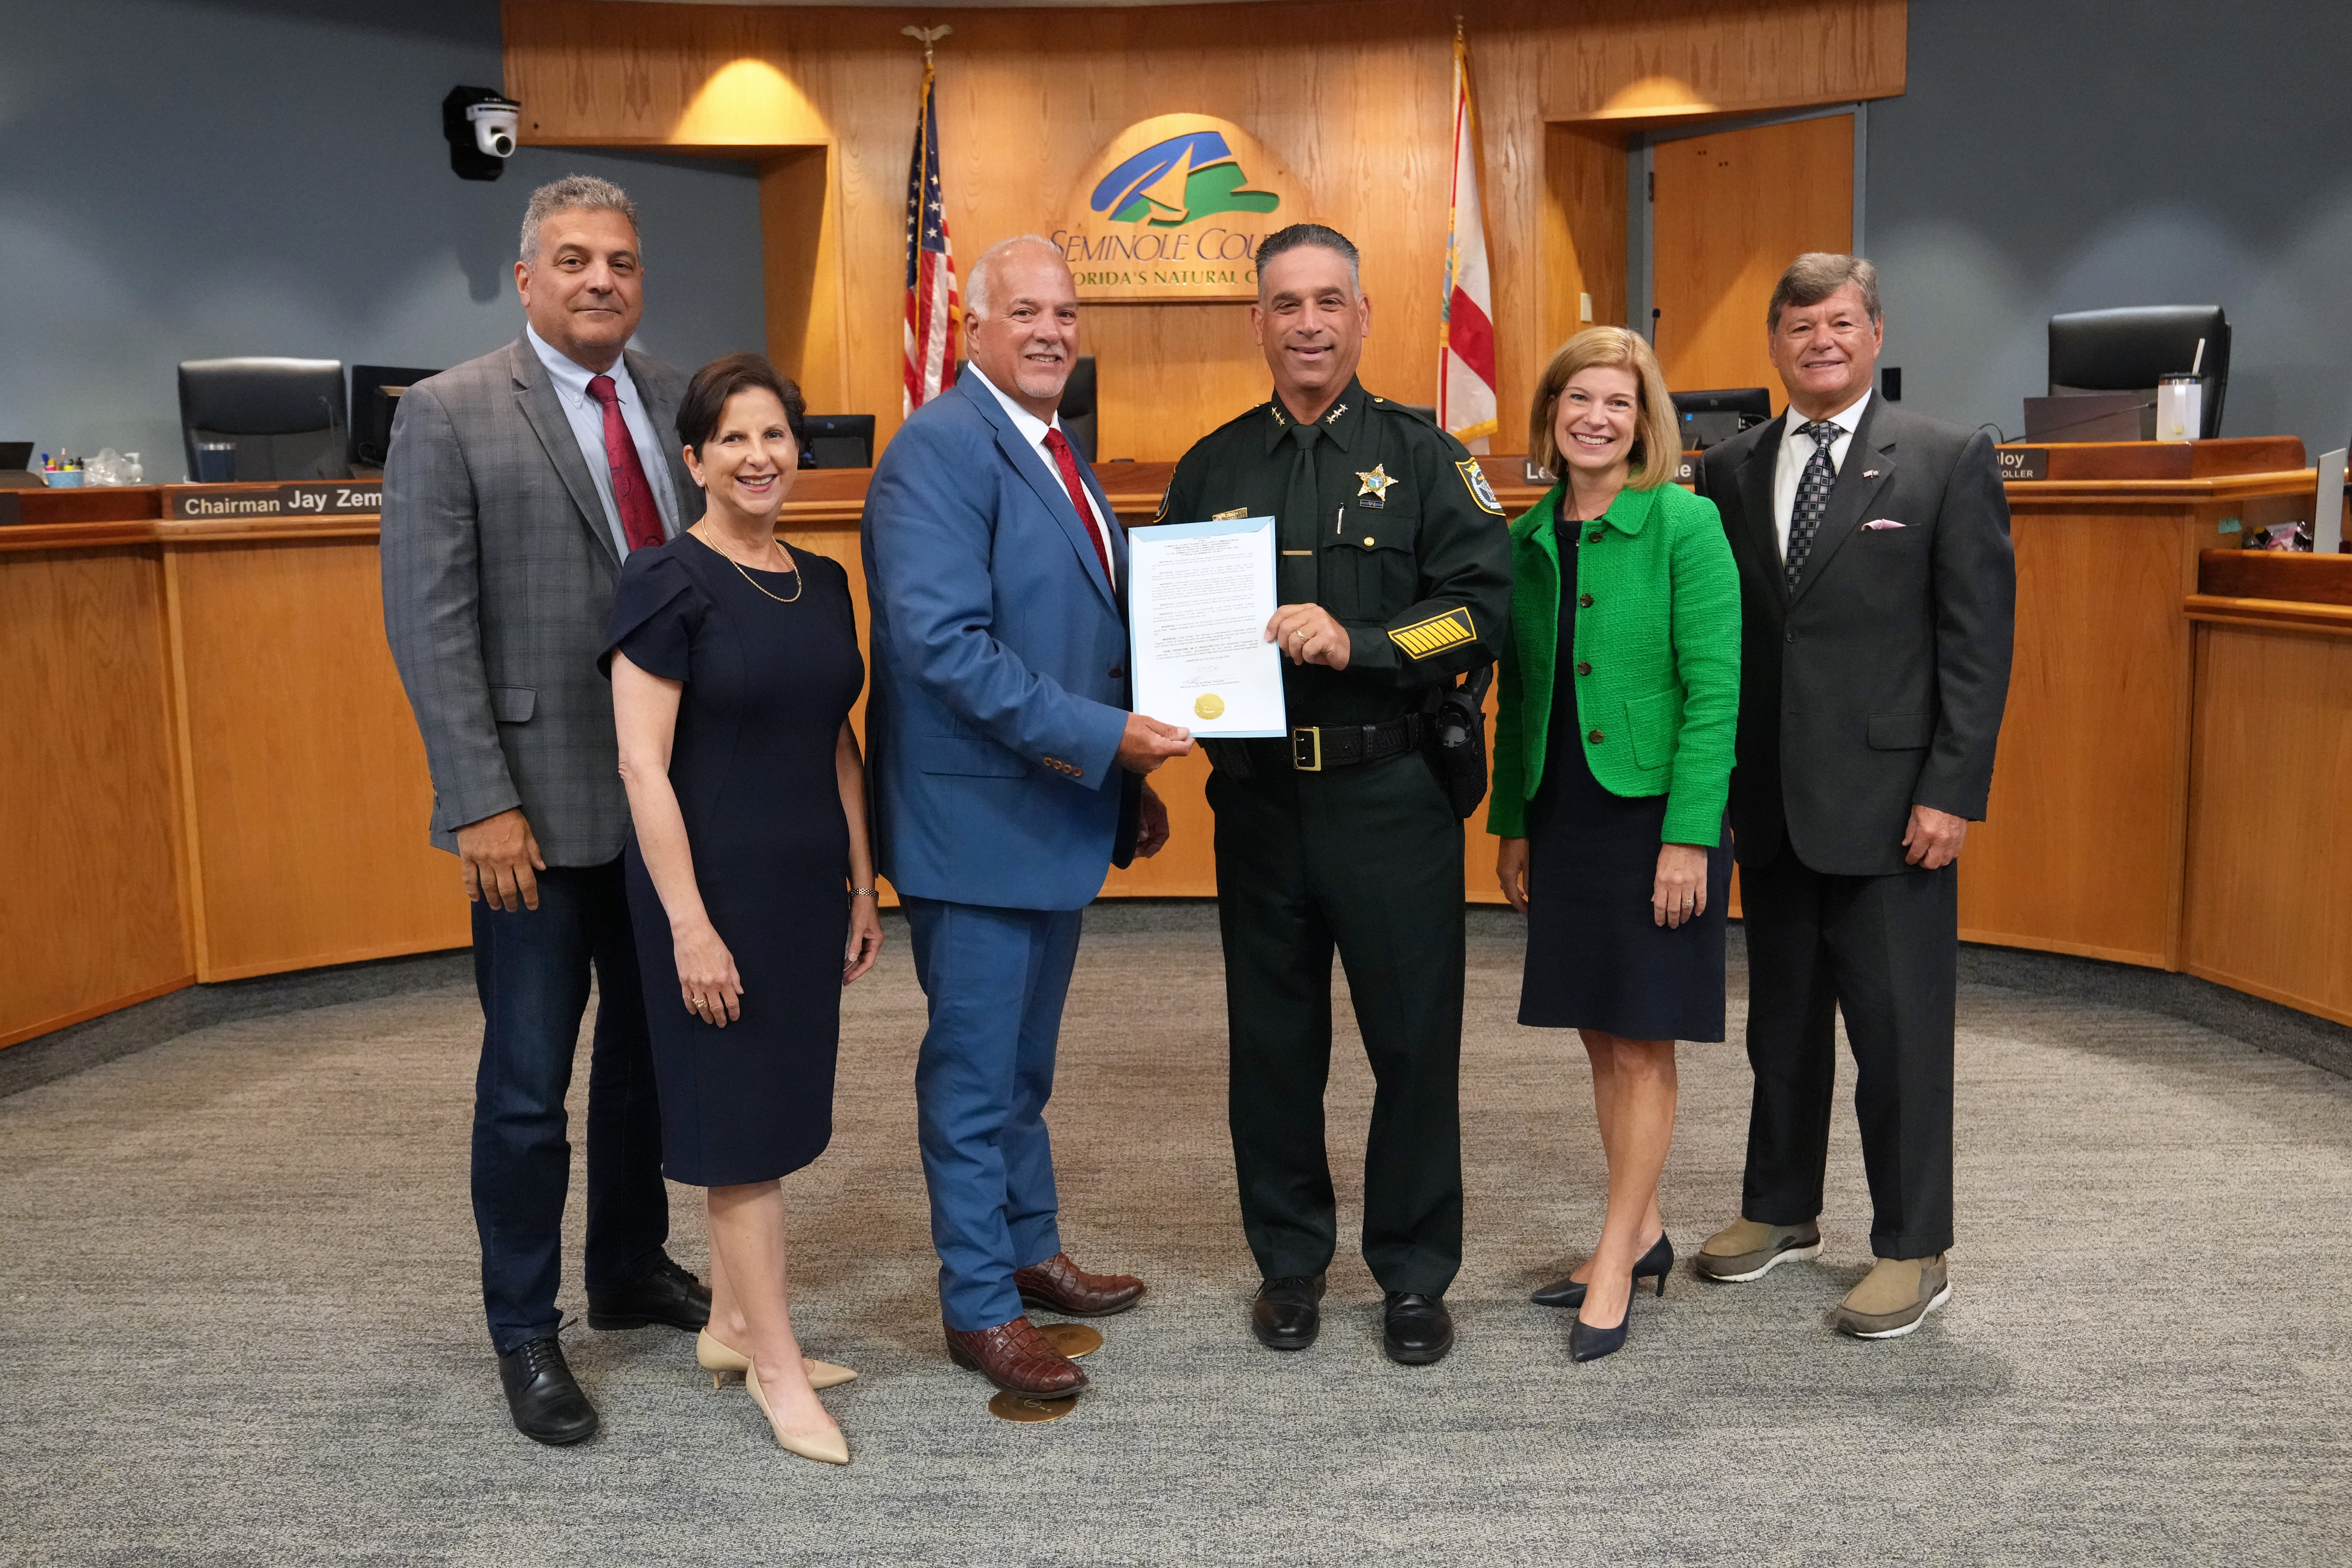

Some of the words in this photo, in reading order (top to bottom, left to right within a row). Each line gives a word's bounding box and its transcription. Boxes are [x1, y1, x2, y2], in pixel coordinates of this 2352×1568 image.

[1197, 228, 1272, 260] COU
[1073, 272, 1147, 286] ORIDA'S
[1154, 271, 1238, 286] NATURAL
[1245, 270, 1257, 285] C
[1997, 452, 2024, 468] loy
[2002, 470, 2033, 478] OLLER
[185, 497, 280, 515] Chairman
[288, 490, 327, 512] Jay
[336, 489, 382, 507] Zem
